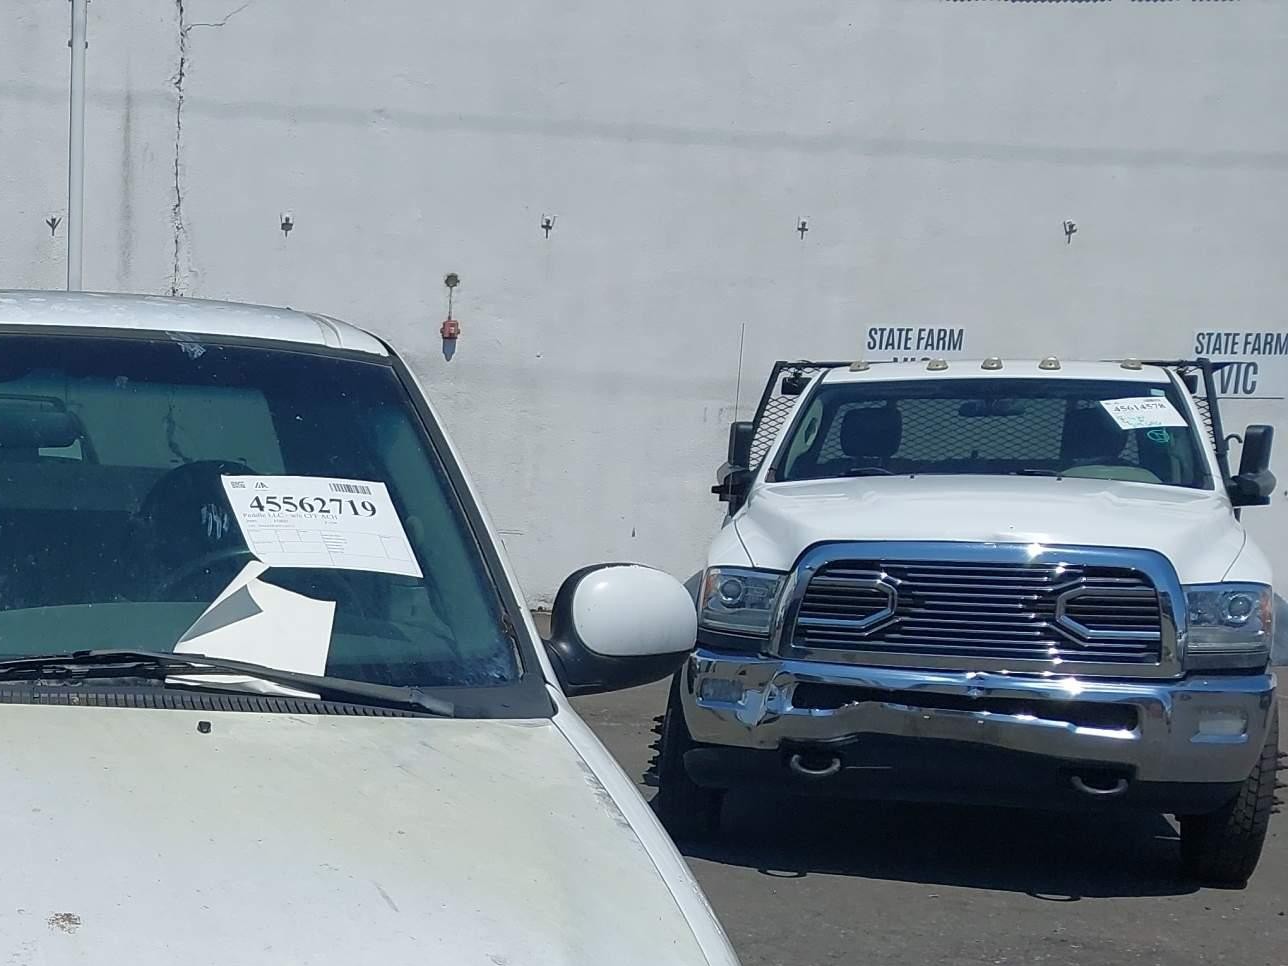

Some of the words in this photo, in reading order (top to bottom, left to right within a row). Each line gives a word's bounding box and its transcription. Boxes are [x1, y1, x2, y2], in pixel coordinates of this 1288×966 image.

[867, 327, 913, 350] STATE
[916, 328, 964, 351] FARM
[1195, 332, 1240, 355] STATE
[1242, 332, 1288, 355] FARM
[1220, 362, 1259, 395] VIC
[249, 495, 377, 518] 45562719
